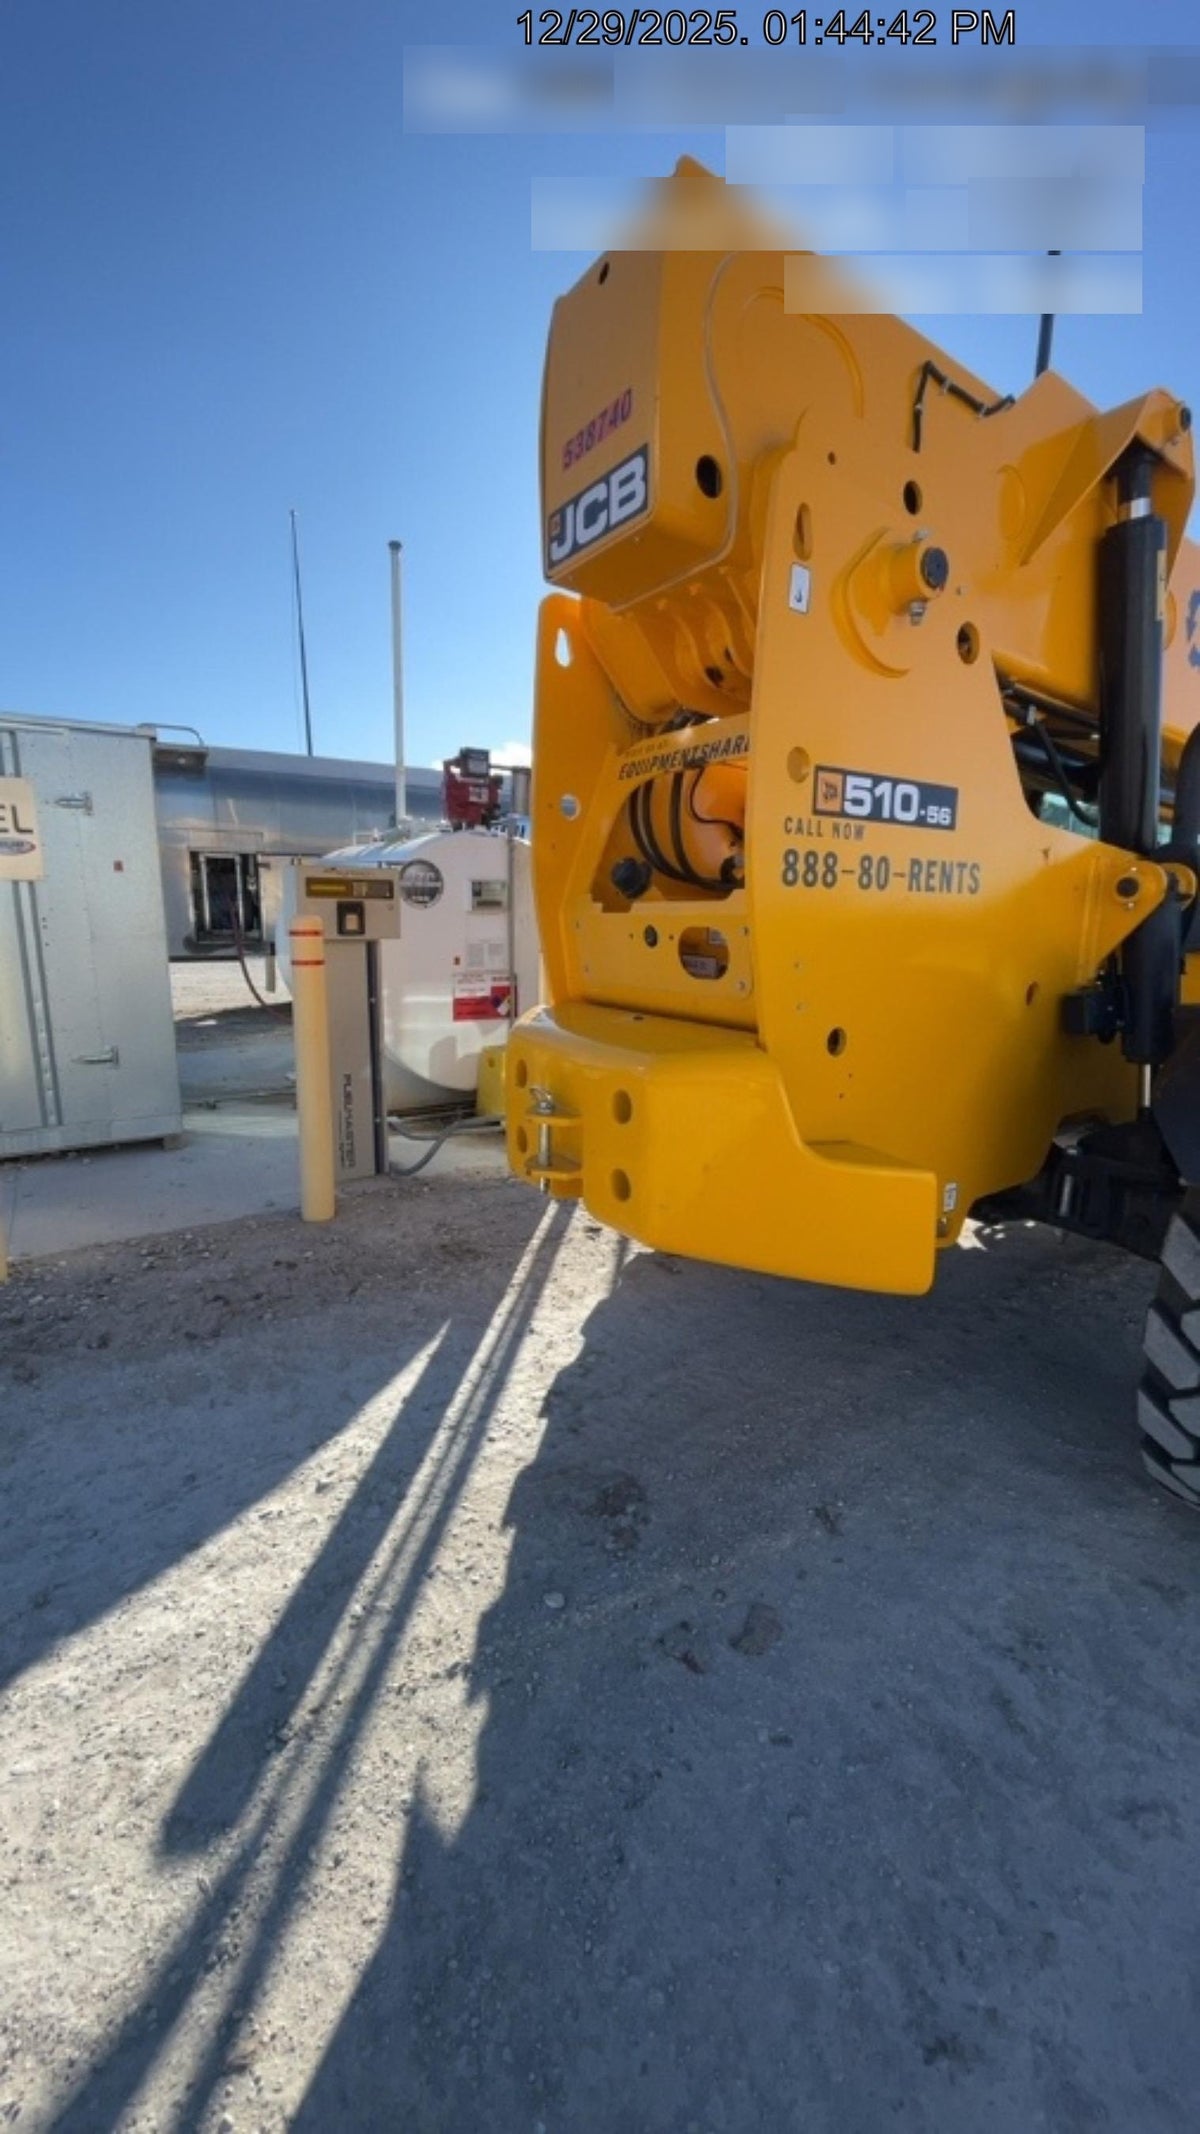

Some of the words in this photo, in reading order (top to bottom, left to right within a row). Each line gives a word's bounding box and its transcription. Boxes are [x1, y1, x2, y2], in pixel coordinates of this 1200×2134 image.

[562, 387, 633, 471] 538740
[551, 453, 646, 562] JCB
[843, 773, 953, 826] 510-56
[784, 816, 824, 839] CALL
[831, 821, 866, 841] NOW
[782, 848, 981, 895] 888-80-RENTS
